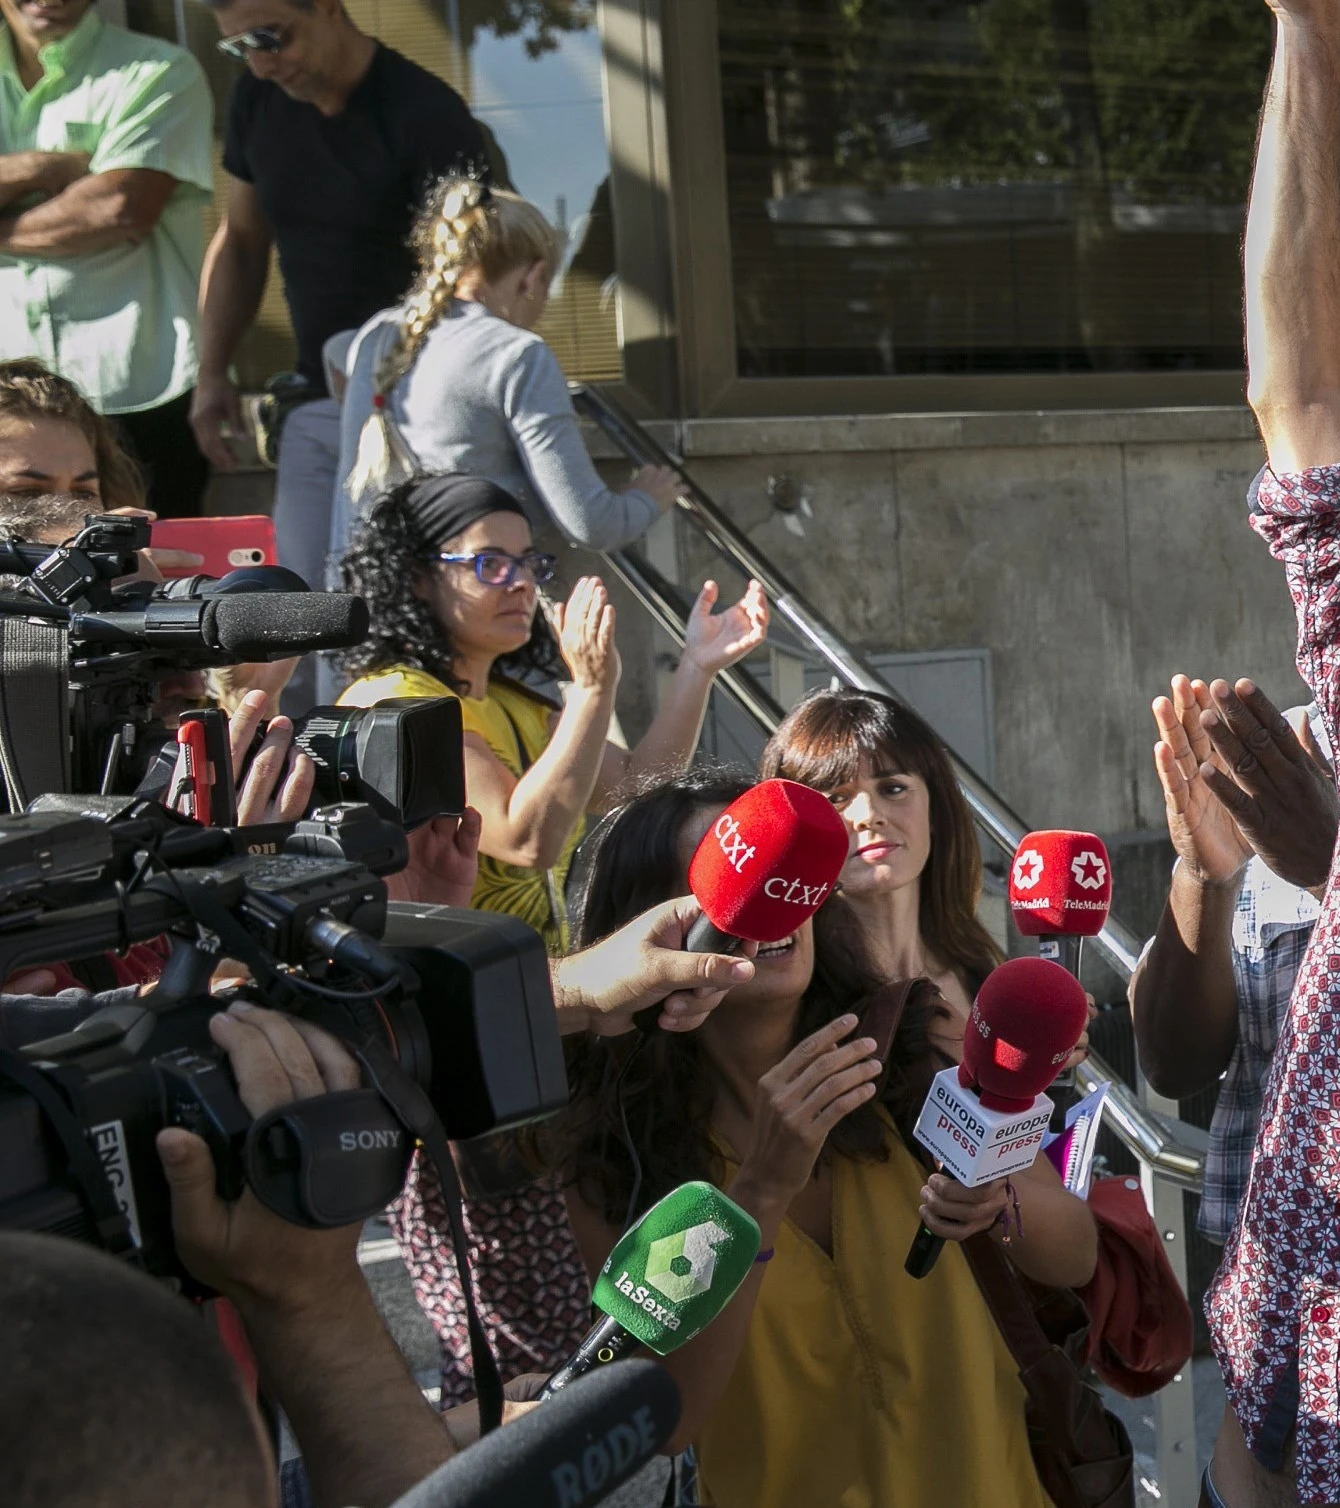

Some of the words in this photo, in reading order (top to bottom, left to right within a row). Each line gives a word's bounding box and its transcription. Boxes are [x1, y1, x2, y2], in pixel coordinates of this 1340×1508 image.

[714, 814, 756, 873] ctxt
[764, 877, 828, 906] ctxt
[936, 1086, 986, 1140] europa
[995, 1112, 1050, 1140] europa
[339, 1128, 400, 1151] SONY
[936, 1113, 978, 1158] press
[998, 1132, 1042, 1158] press
[614, 1271, 681, 1331] laSexta
